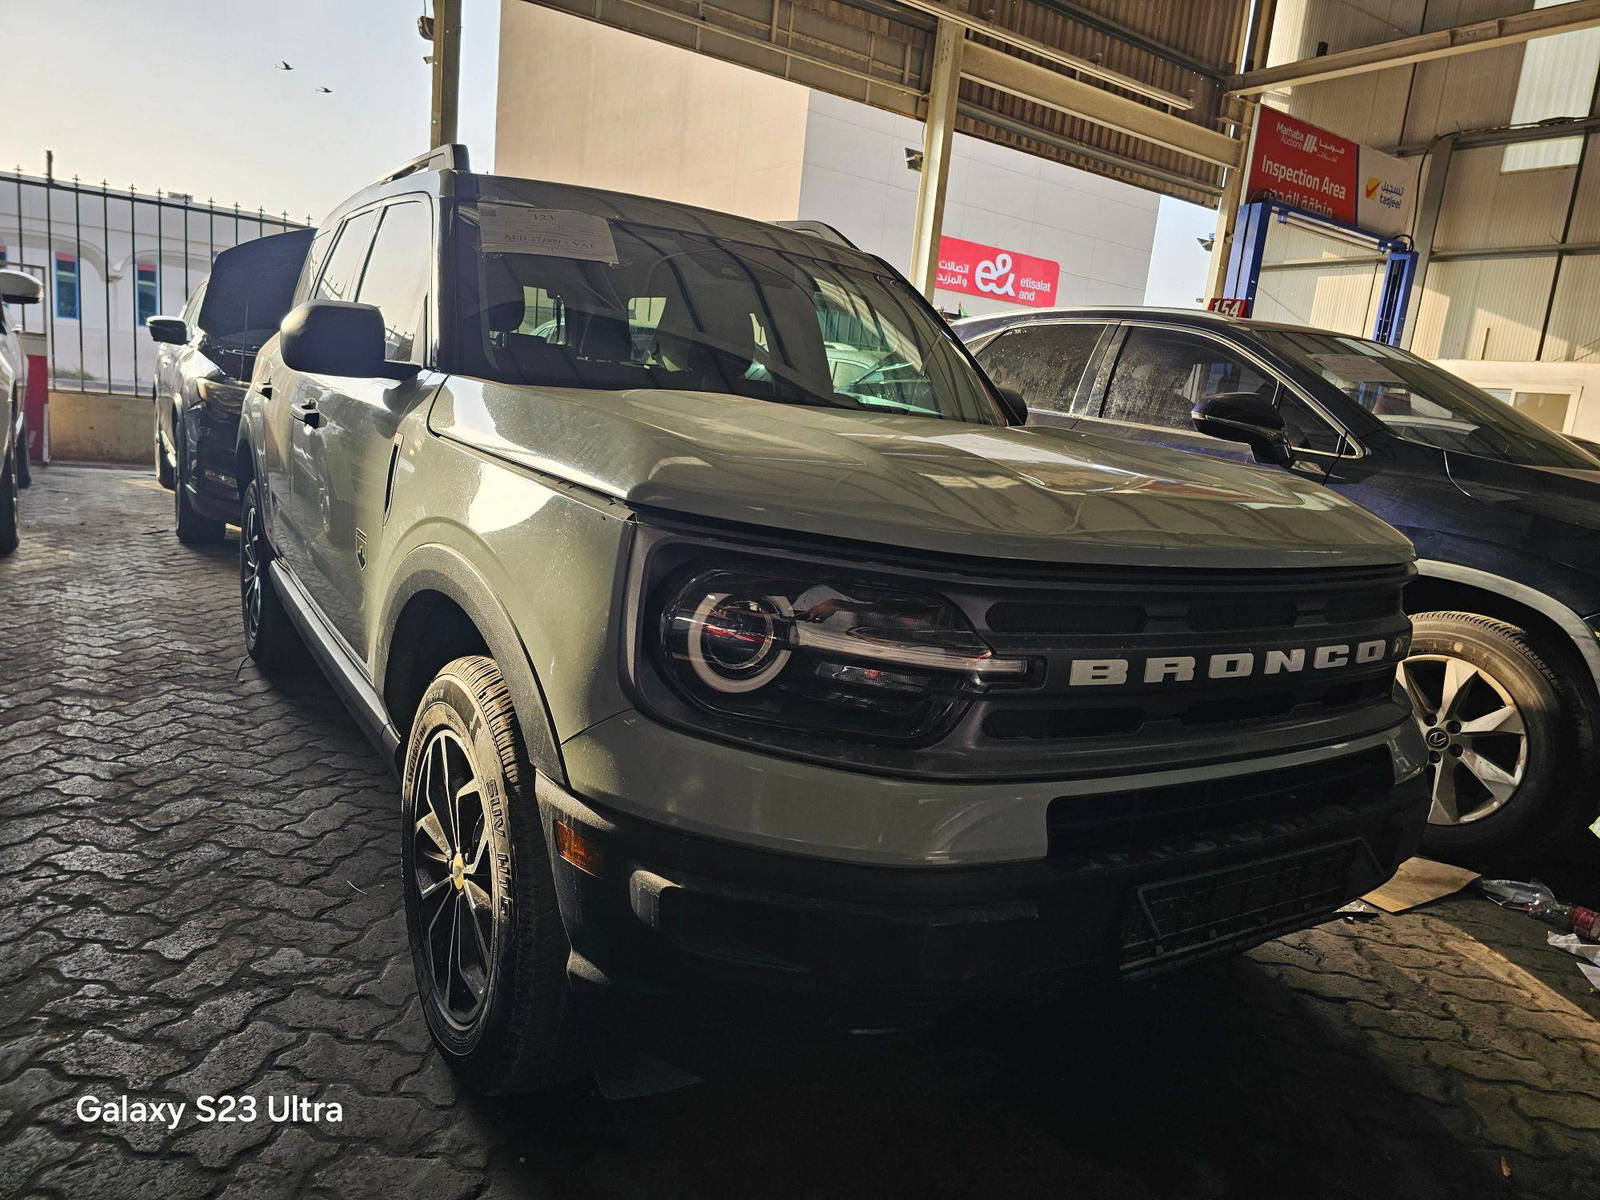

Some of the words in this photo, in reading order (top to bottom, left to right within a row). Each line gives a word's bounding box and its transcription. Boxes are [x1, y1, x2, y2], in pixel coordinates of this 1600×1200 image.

[1261, 154, 1321, 192] Inspection
[1320, 176, 1346, 200] Area
[1379, 193, 1402, 210] tasjeel
[938, 260, 969, 274] اتصالات
[936, 272, 968, 288] والمزيد
[1019, 277, 1051, 293] etisalat
[1018, 289, 1036, 301] and
[1213, 299, 1242, 320] 154
[1069, 639, 1386, 686] BRONCO
[486, 778, 506, 839] SUV
